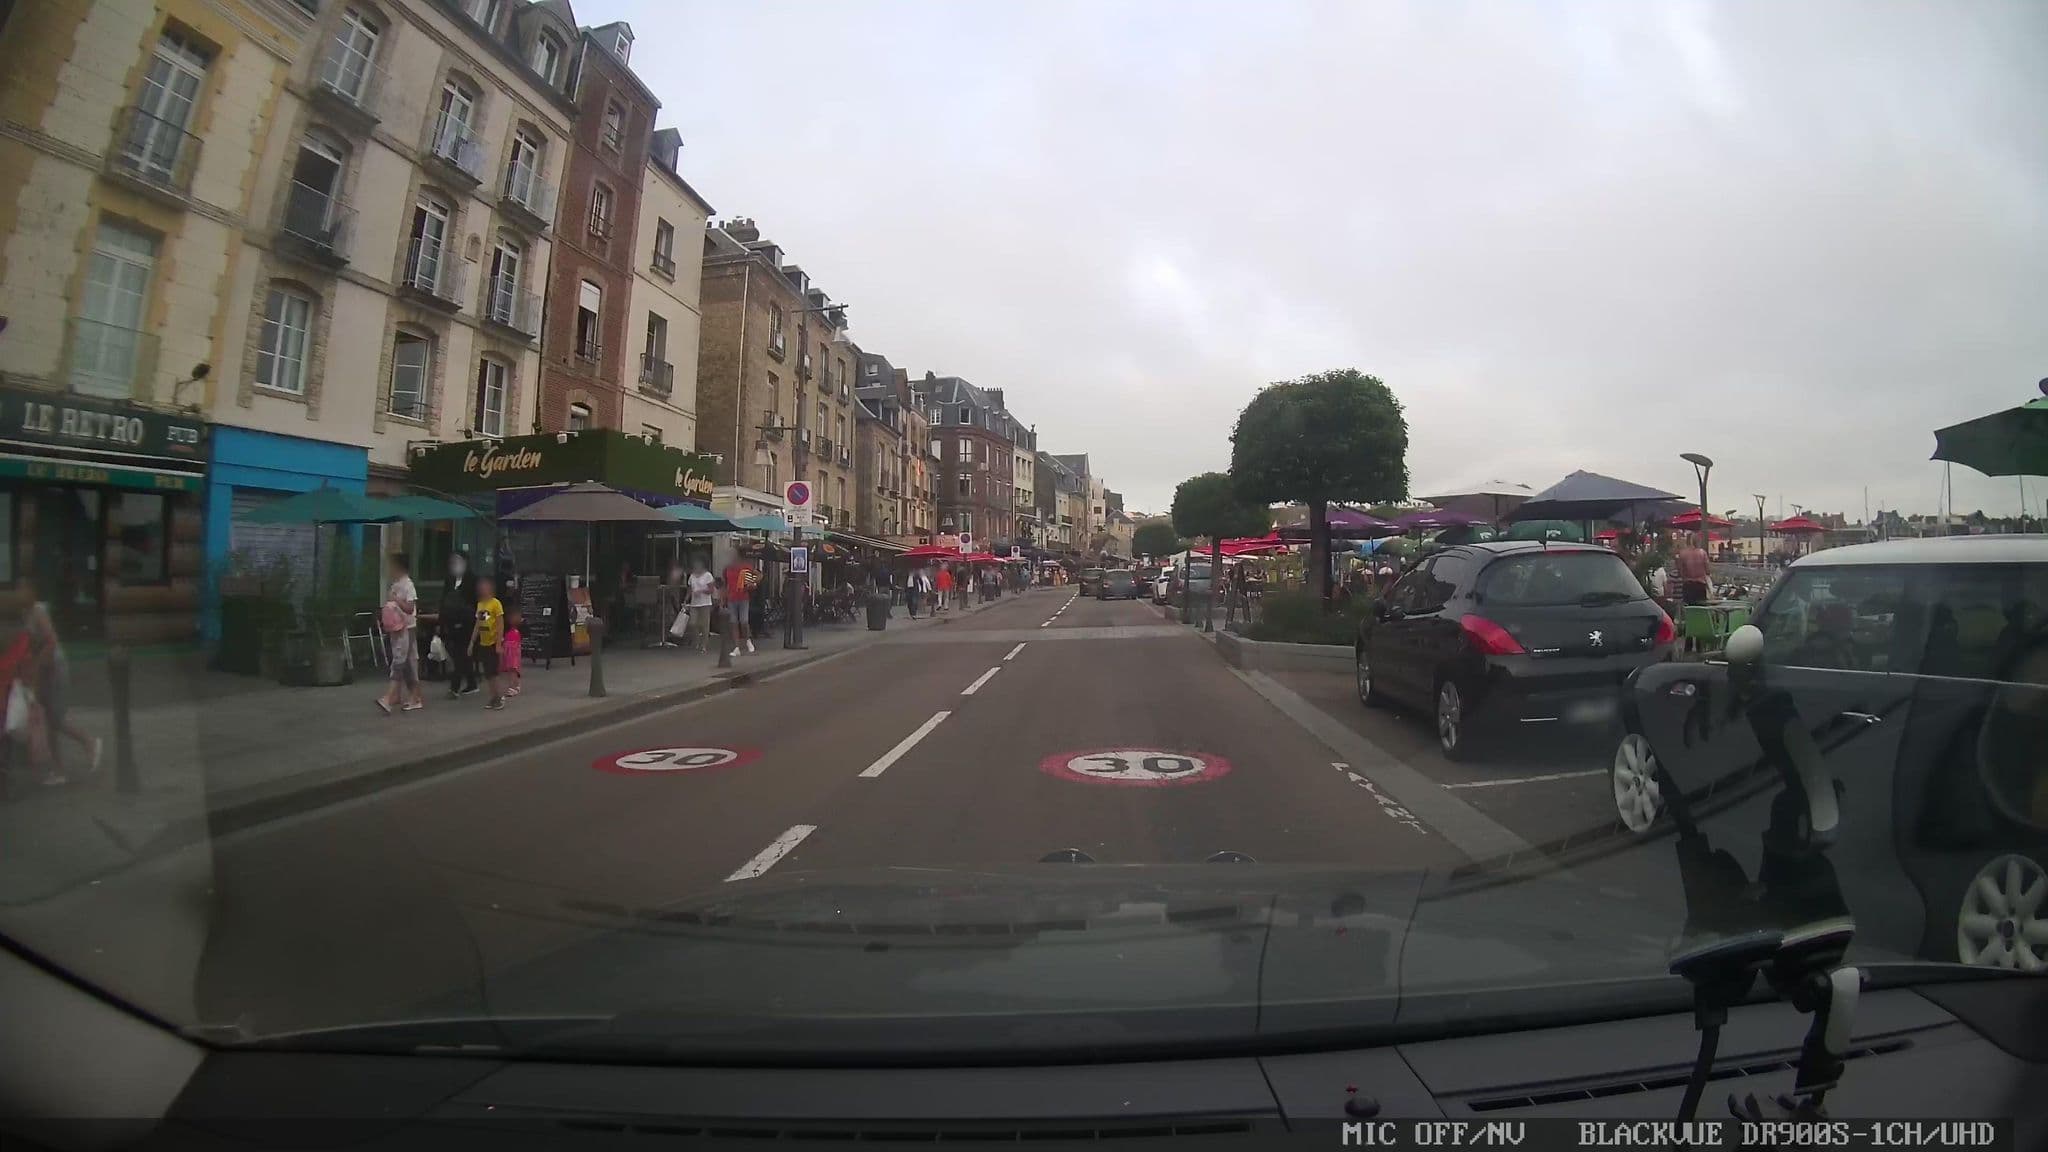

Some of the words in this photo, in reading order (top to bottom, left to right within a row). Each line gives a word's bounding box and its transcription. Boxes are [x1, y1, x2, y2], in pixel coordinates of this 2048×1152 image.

[22, 402, 54, 432] LE
[60, 407, 144, 445] RETRO
[167, 425, 198, 444] PUB
[463, 450, 479, 473] le
[480, 446, 542, 479] Garden
[675, 467, 682, 488] le
[683, 468, 714, 497] Garden
[625, 752, 728, 765] 30
[1083, 757, 1194, 773] 30
